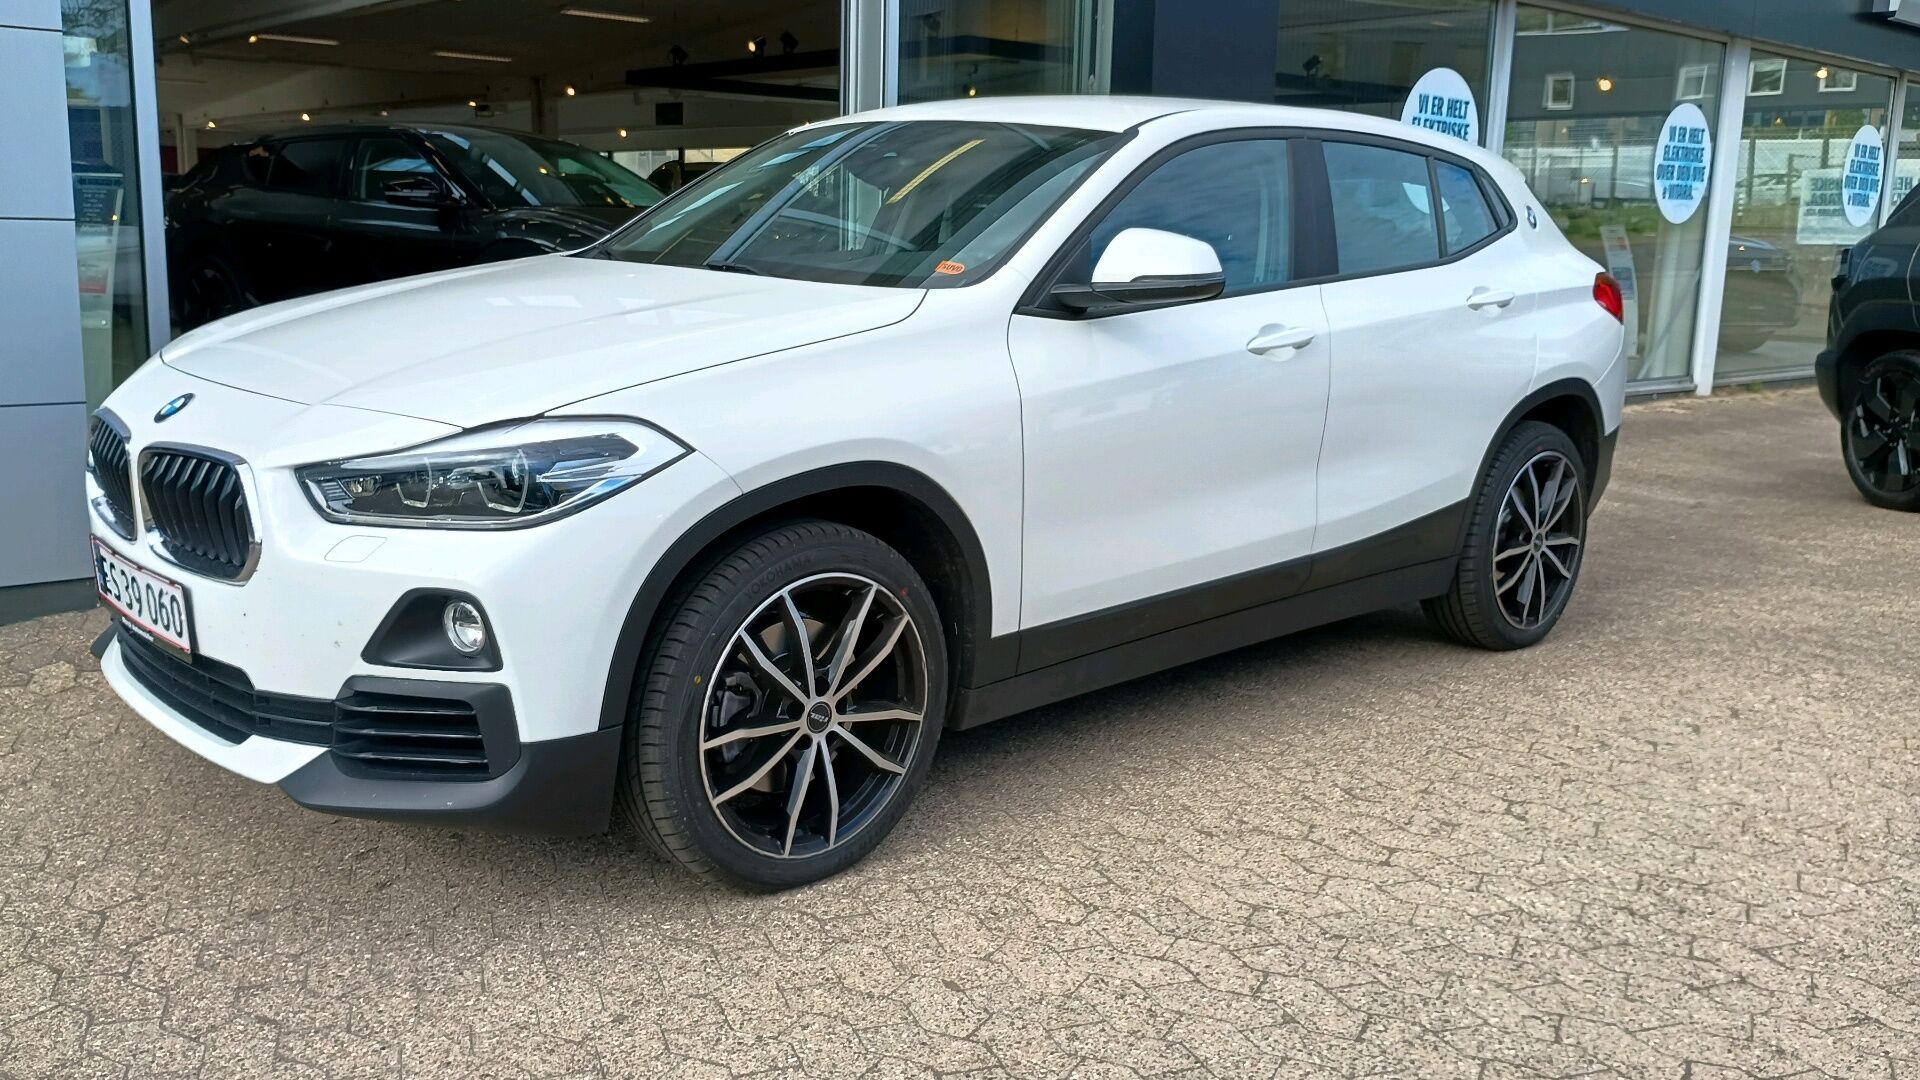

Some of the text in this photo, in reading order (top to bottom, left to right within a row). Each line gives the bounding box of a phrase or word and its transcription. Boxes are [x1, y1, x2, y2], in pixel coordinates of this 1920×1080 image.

[1418, 93, 1470, 120] VI ER HELT
[1677, 126, 1687, 143] ER
[1687, 127, 1705, 144] HELT
[121, 568, 142, 618] 39
[145, 582, 183, 639] 060
